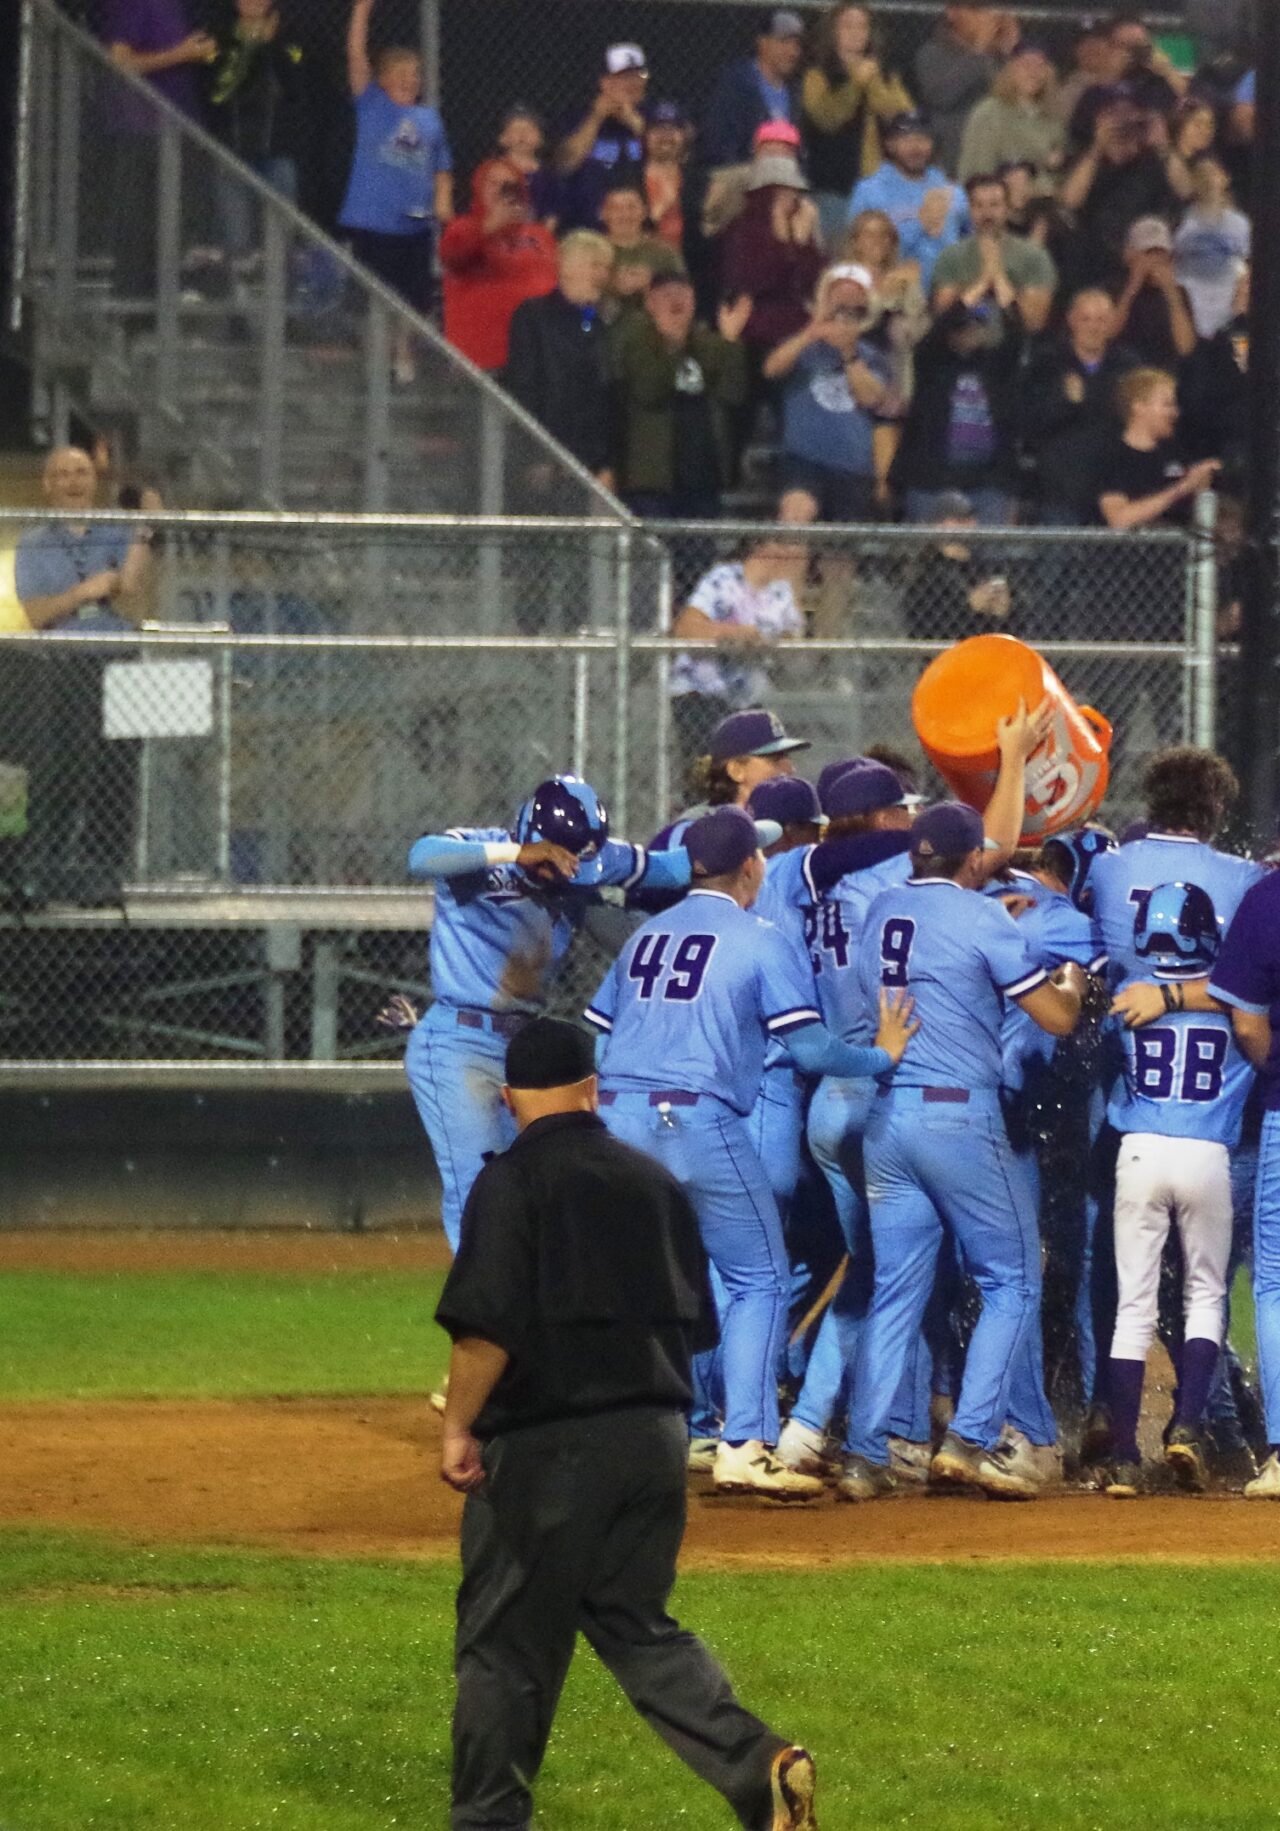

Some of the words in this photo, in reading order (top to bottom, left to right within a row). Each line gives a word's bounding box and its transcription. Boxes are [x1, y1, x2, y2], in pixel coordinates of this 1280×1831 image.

[629, 932, 718, 1002] 49
[881, 916, 916, 987] 9
[1131, 1024, 1231, 1104] 88
